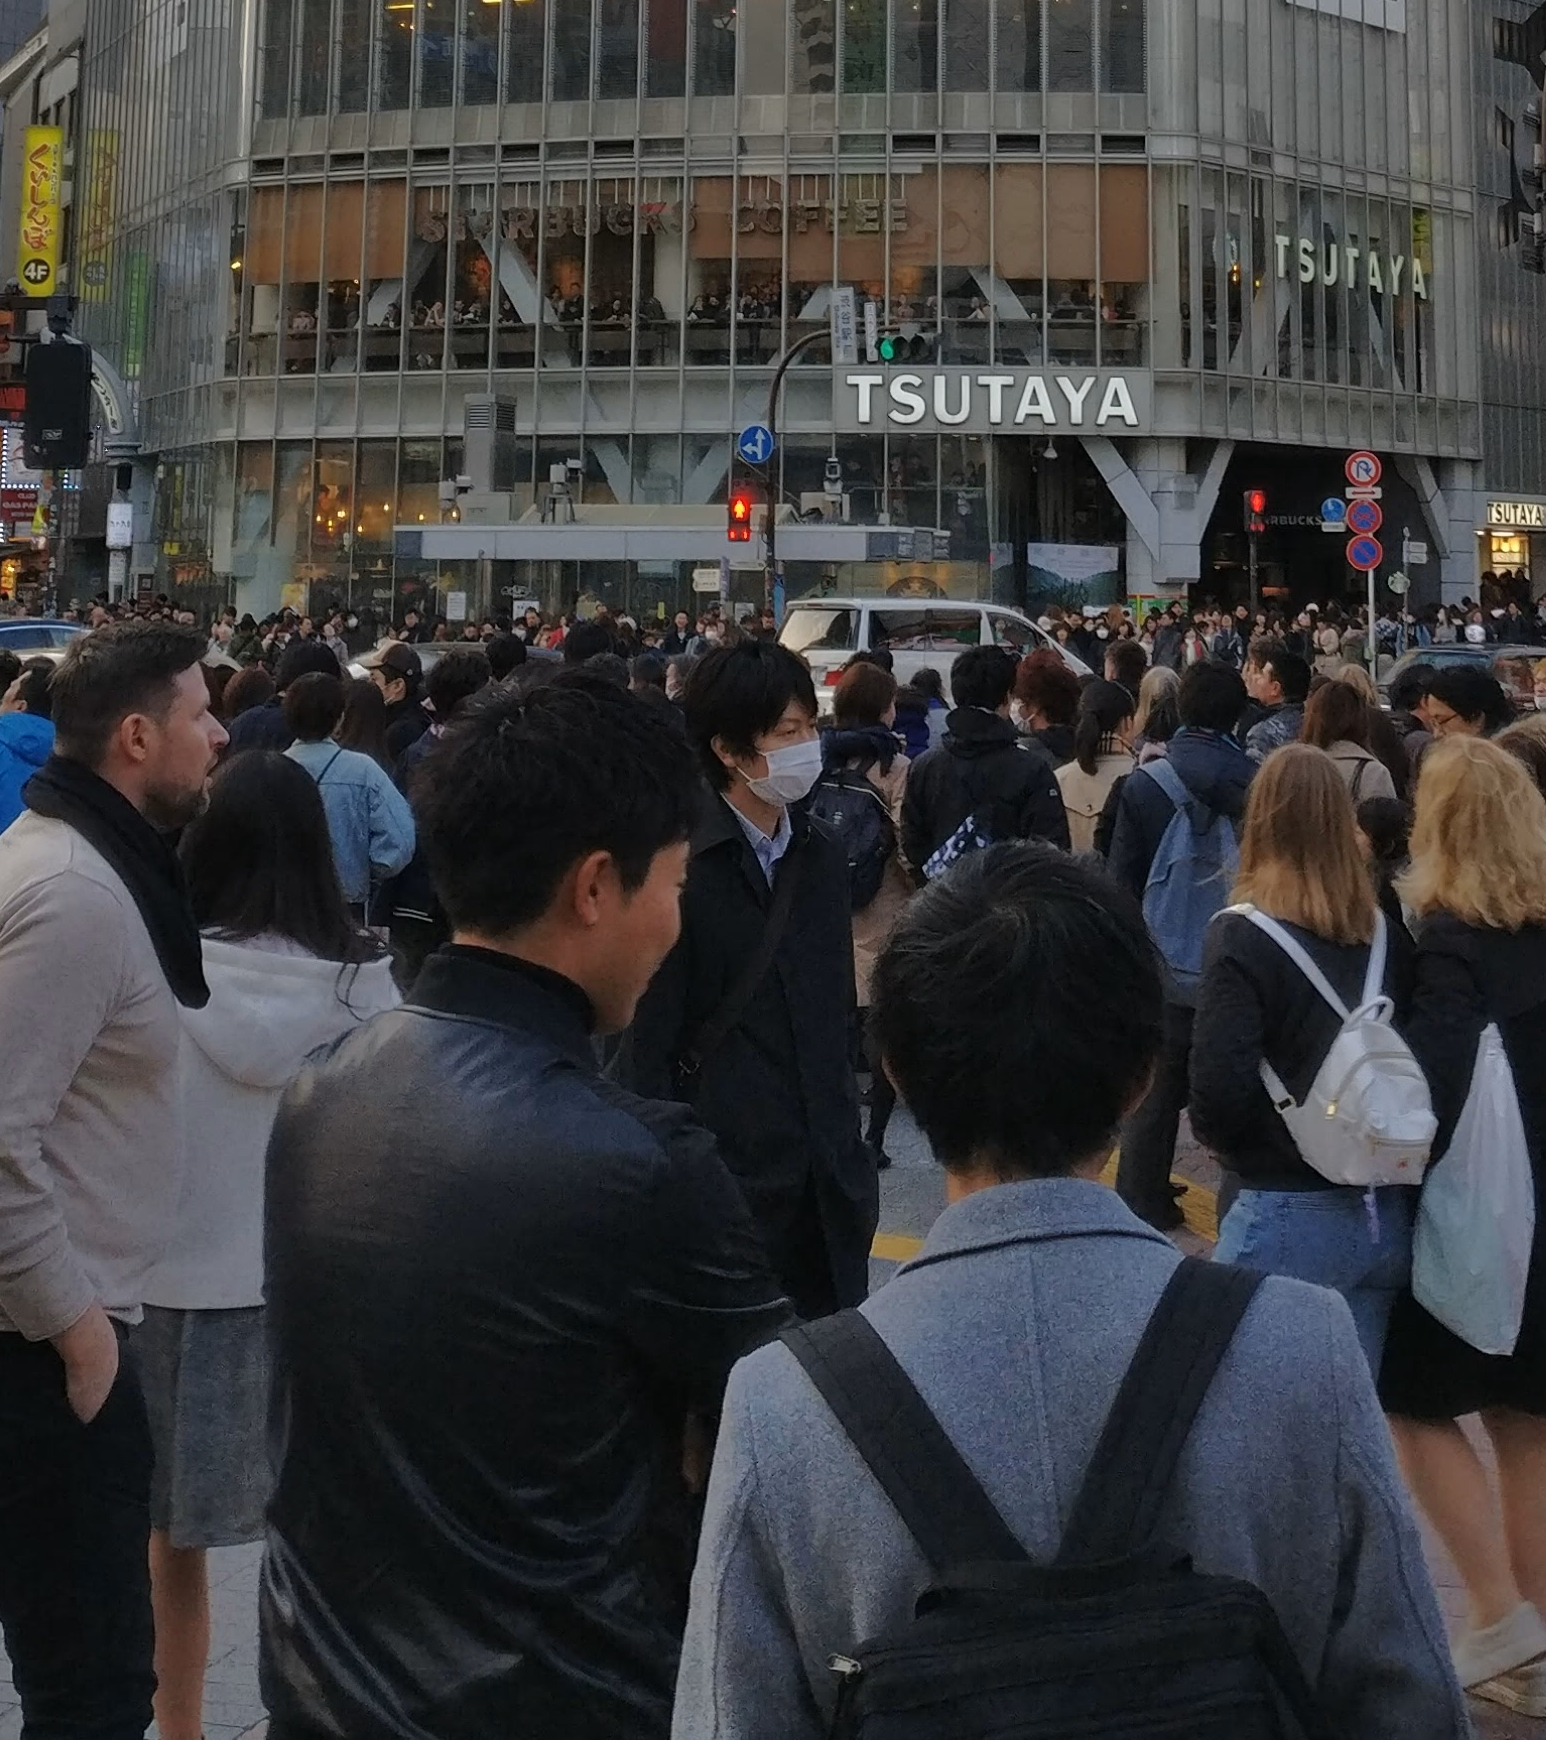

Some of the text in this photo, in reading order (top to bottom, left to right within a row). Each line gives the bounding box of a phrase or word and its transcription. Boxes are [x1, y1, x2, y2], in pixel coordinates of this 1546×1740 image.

[23, 143, 51, 252] くいしんぼ
[418, 198, 908, 243] STARBUCKS COFFEE
[24, 264, 49, 279] 4F
[1274, 234, 1429, 300] TSUTAYA
[847, 373, 1139, 427] TSUTAYA
[1487, 502, 1543, 526] TSUTAYA
